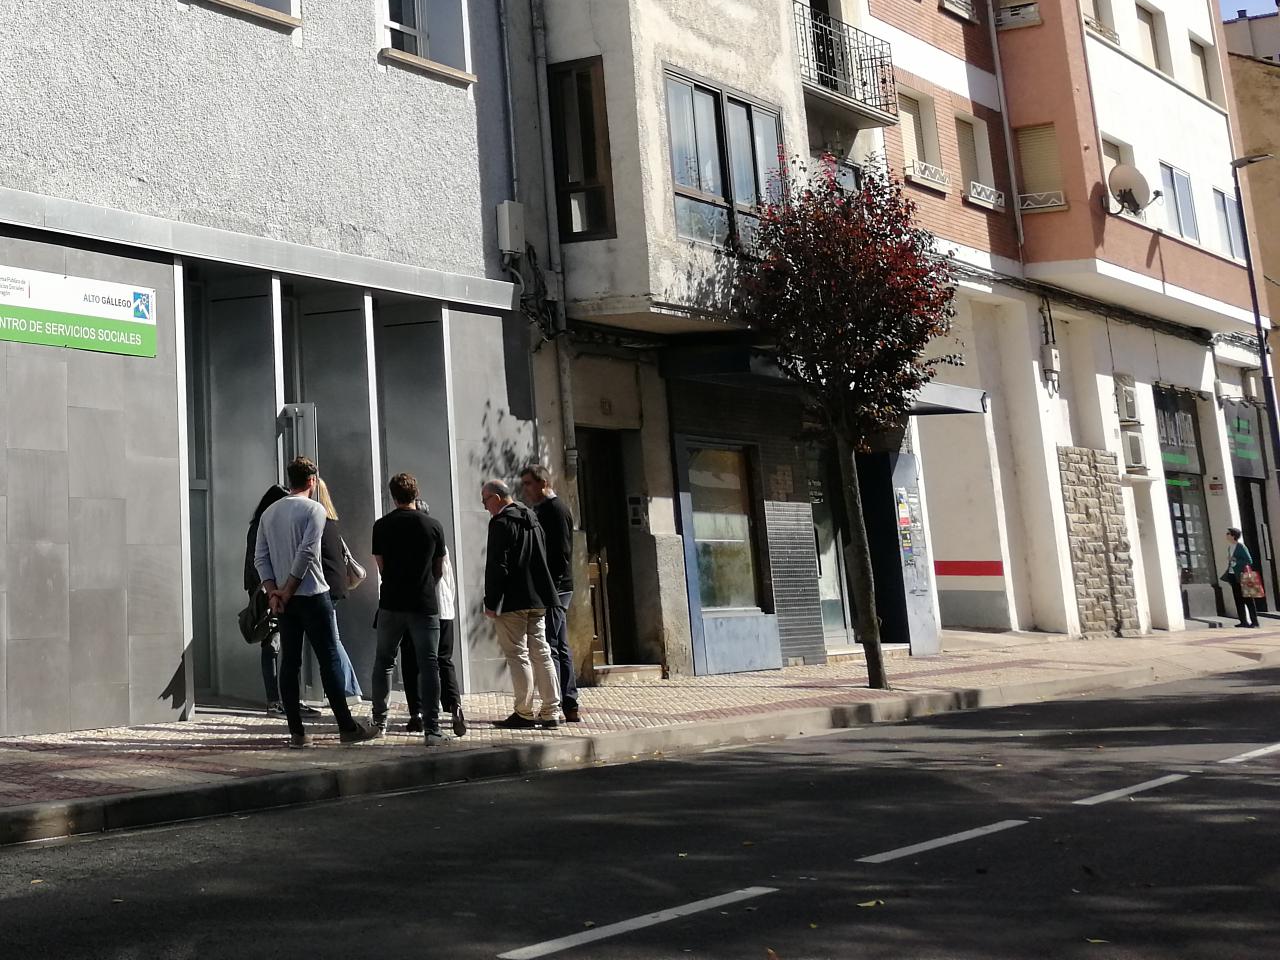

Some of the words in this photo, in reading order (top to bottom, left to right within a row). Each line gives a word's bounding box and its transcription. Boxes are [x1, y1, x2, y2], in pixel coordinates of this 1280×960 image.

[83, 293, 100, 304] ALTO
[101, 295, 132, 309] GÁLLEGO
[29, 321, 43, 334] DE
[45, 323, 96, 340] SERVICIOS
[98, 328, 142, 346] SOCIALES
